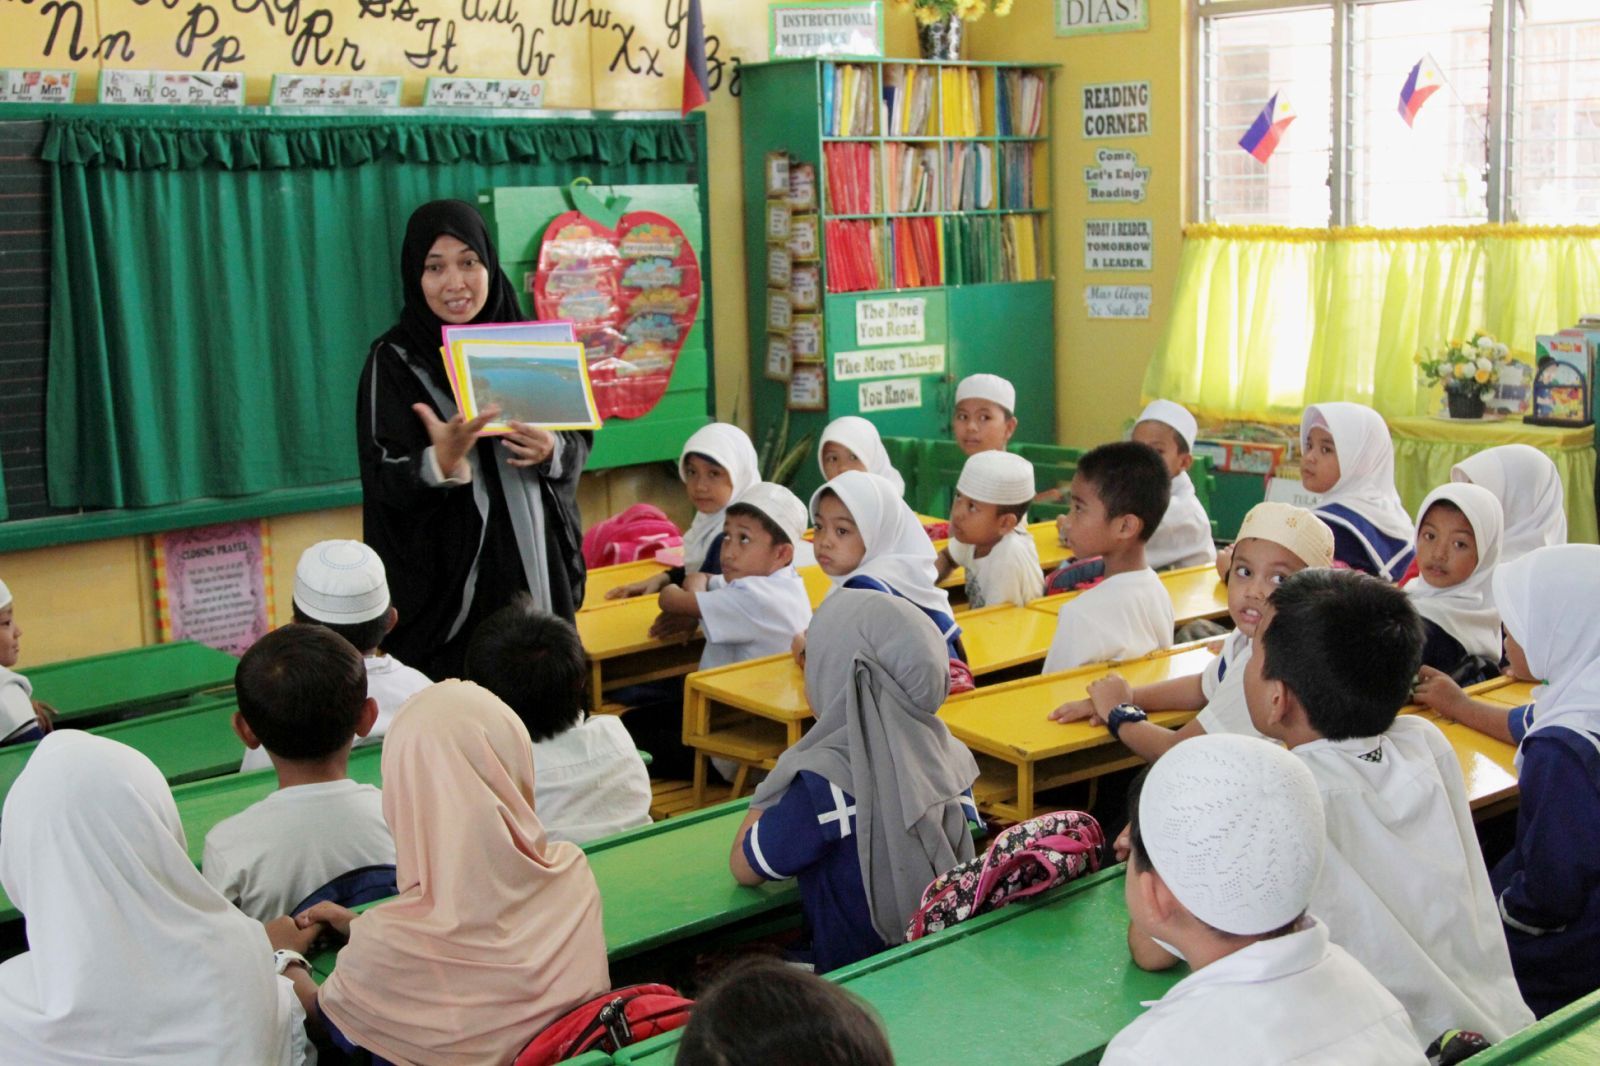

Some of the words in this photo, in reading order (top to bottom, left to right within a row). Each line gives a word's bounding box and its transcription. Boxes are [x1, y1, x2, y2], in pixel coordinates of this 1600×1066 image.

[782, 12, 873, 27] INSTRUCTIONAL
[1066, 0, 1138, 26] DIAS!
[1084, 84, 1148, 109] READING
[1085, 112, 1148, 136] CORNER
[1086, 170, 1112, 180] Let's
[1116, 169, 1148, 181] Enjoy
[1087, 242, 1151, 251] TOMORROW
[1092, 258, 1098, 267] A
[862, 304, 885, 320] The
[888, 302, 919, 318] More
[860, 322, 883, 338] You
[837, 358, 860, 375] The
[864, 356, 896, 372] More
[862, 387, 882, 407] You
[181, 546, 215, 560] CLOSING
[217, 541, 248, 554] PRAYER
